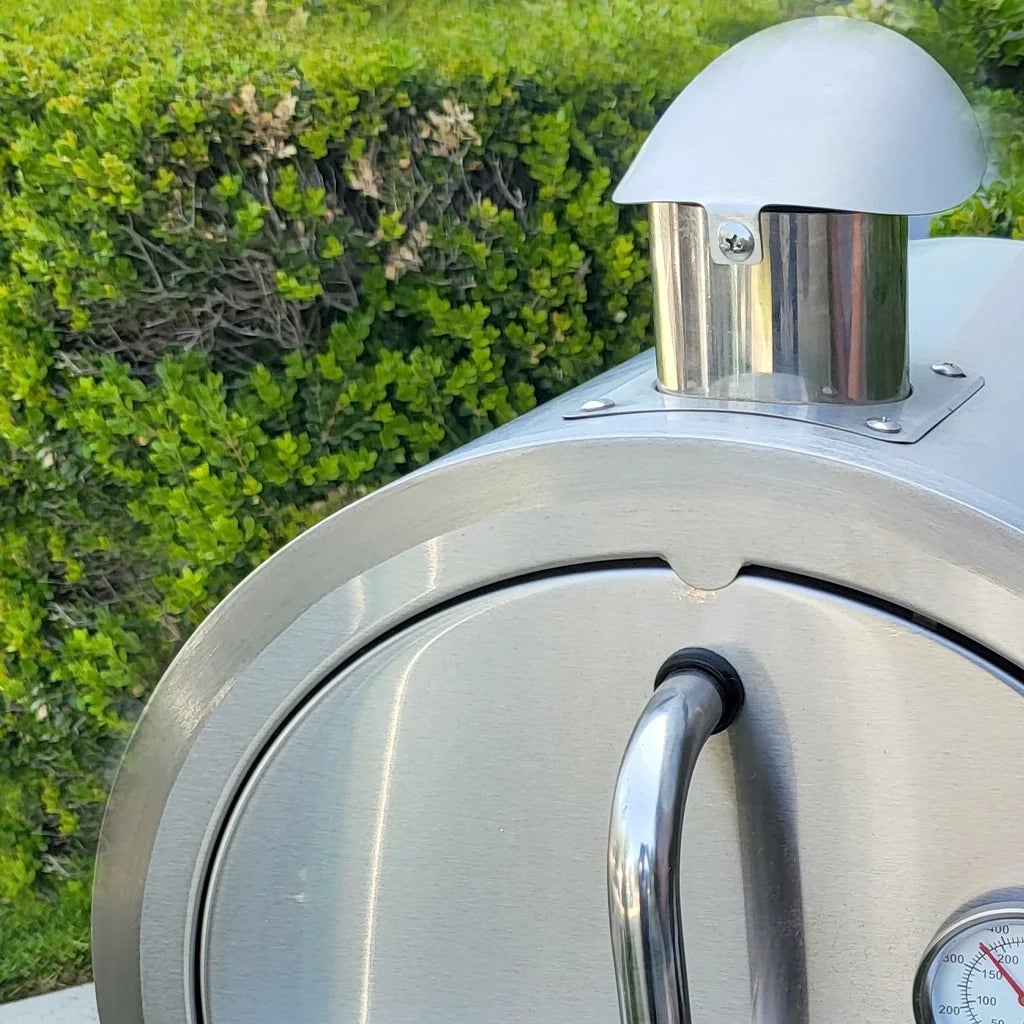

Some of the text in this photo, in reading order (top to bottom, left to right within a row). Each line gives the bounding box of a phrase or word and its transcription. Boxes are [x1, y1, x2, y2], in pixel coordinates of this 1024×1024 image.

[998, 953, 1019, 965] 200
[982, 970, 1003, 980] 150
[977, 995, 997, 1006] 100
[939, 1005, 960, 1015] 200
